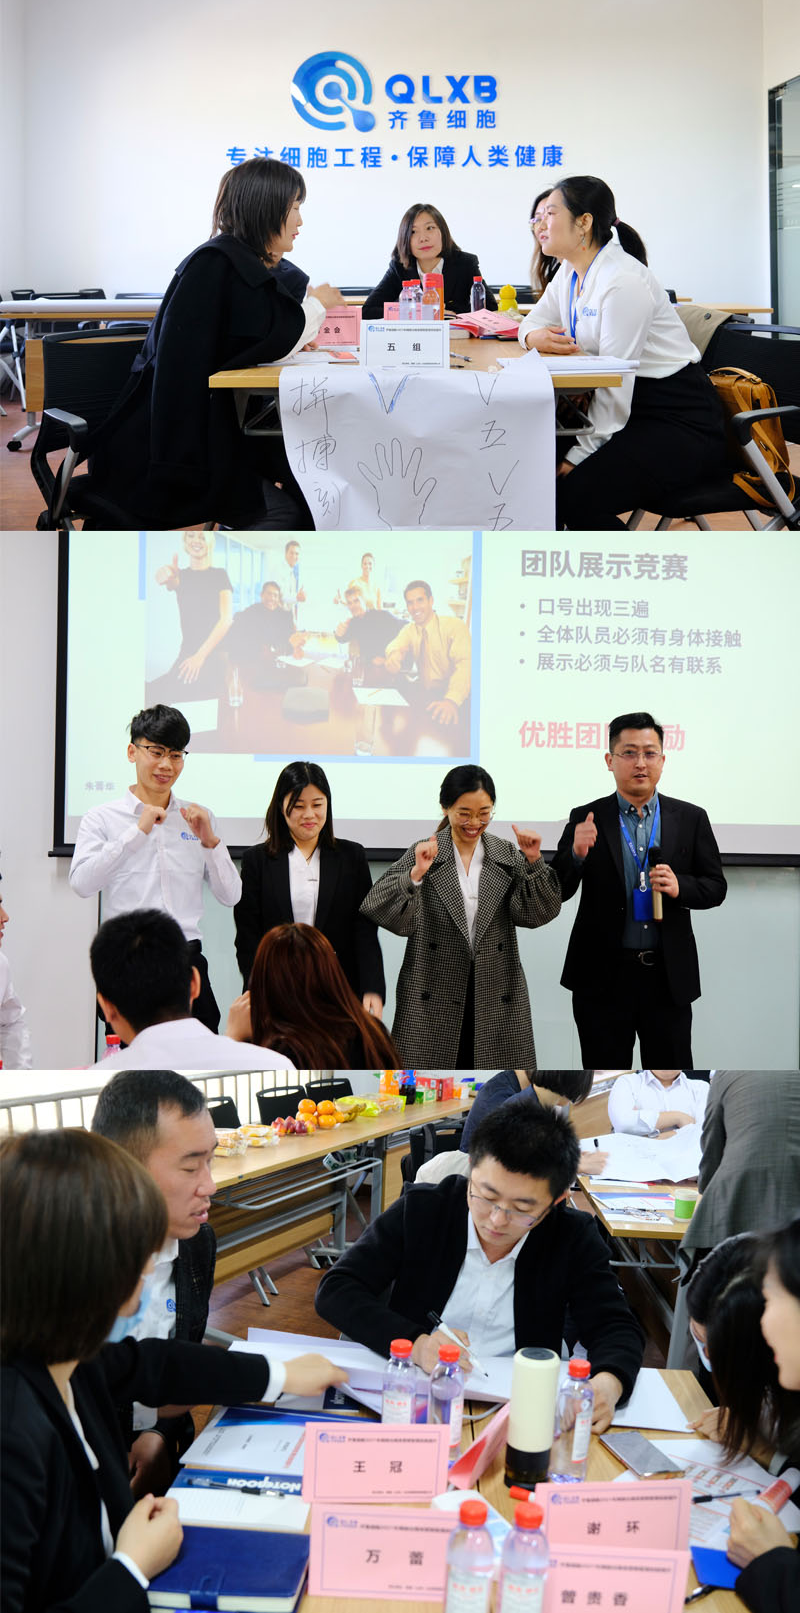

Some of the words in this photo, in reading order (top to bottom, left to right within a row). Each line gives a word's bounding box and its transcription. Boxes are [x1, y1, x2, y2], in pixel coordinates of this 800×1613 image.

[385, 73, 497, 104] QLXB
[388, 109, 496, 130] 齐鲁细胞
[521, 550, 689, 581] 团队展示竞赛
[538, 598, 650, 618] 口号出现三遍
[537, 624, 742, 648] 全体队员必须有身体接触
[536, 653, 723, 675] 展示必须与队名有联系
[518, 721, 686, 751] 优胜团励
